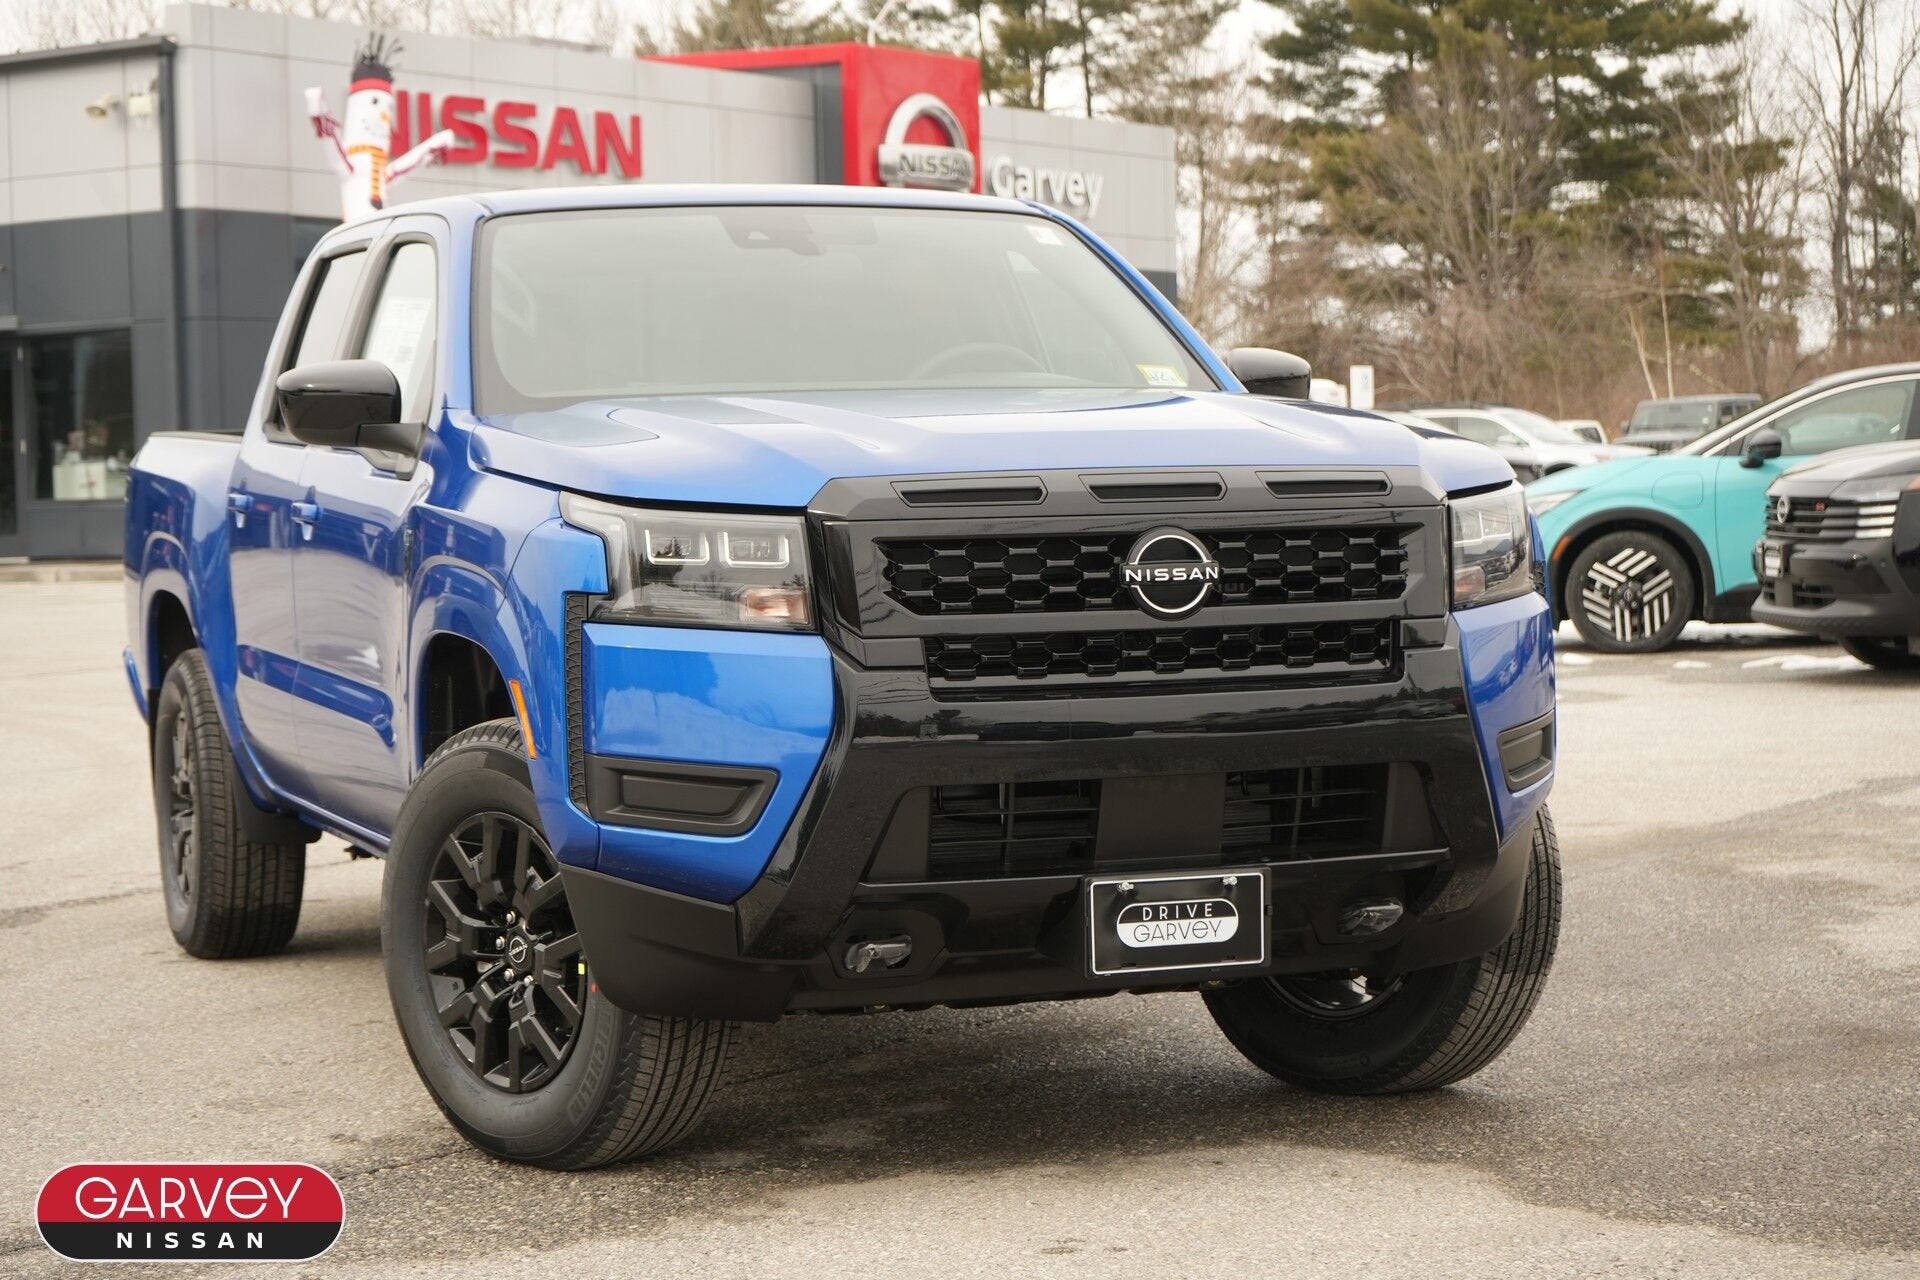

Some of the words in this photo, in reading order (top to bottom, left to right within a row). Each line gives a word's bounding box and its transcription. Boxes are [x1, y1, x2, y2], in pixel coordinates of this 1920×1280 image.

[991, 154, 1104, 219] Garvey
[1125, 566, 1218, 582] NISSAN
[1142, 903, 1213, 921] DRIVE
